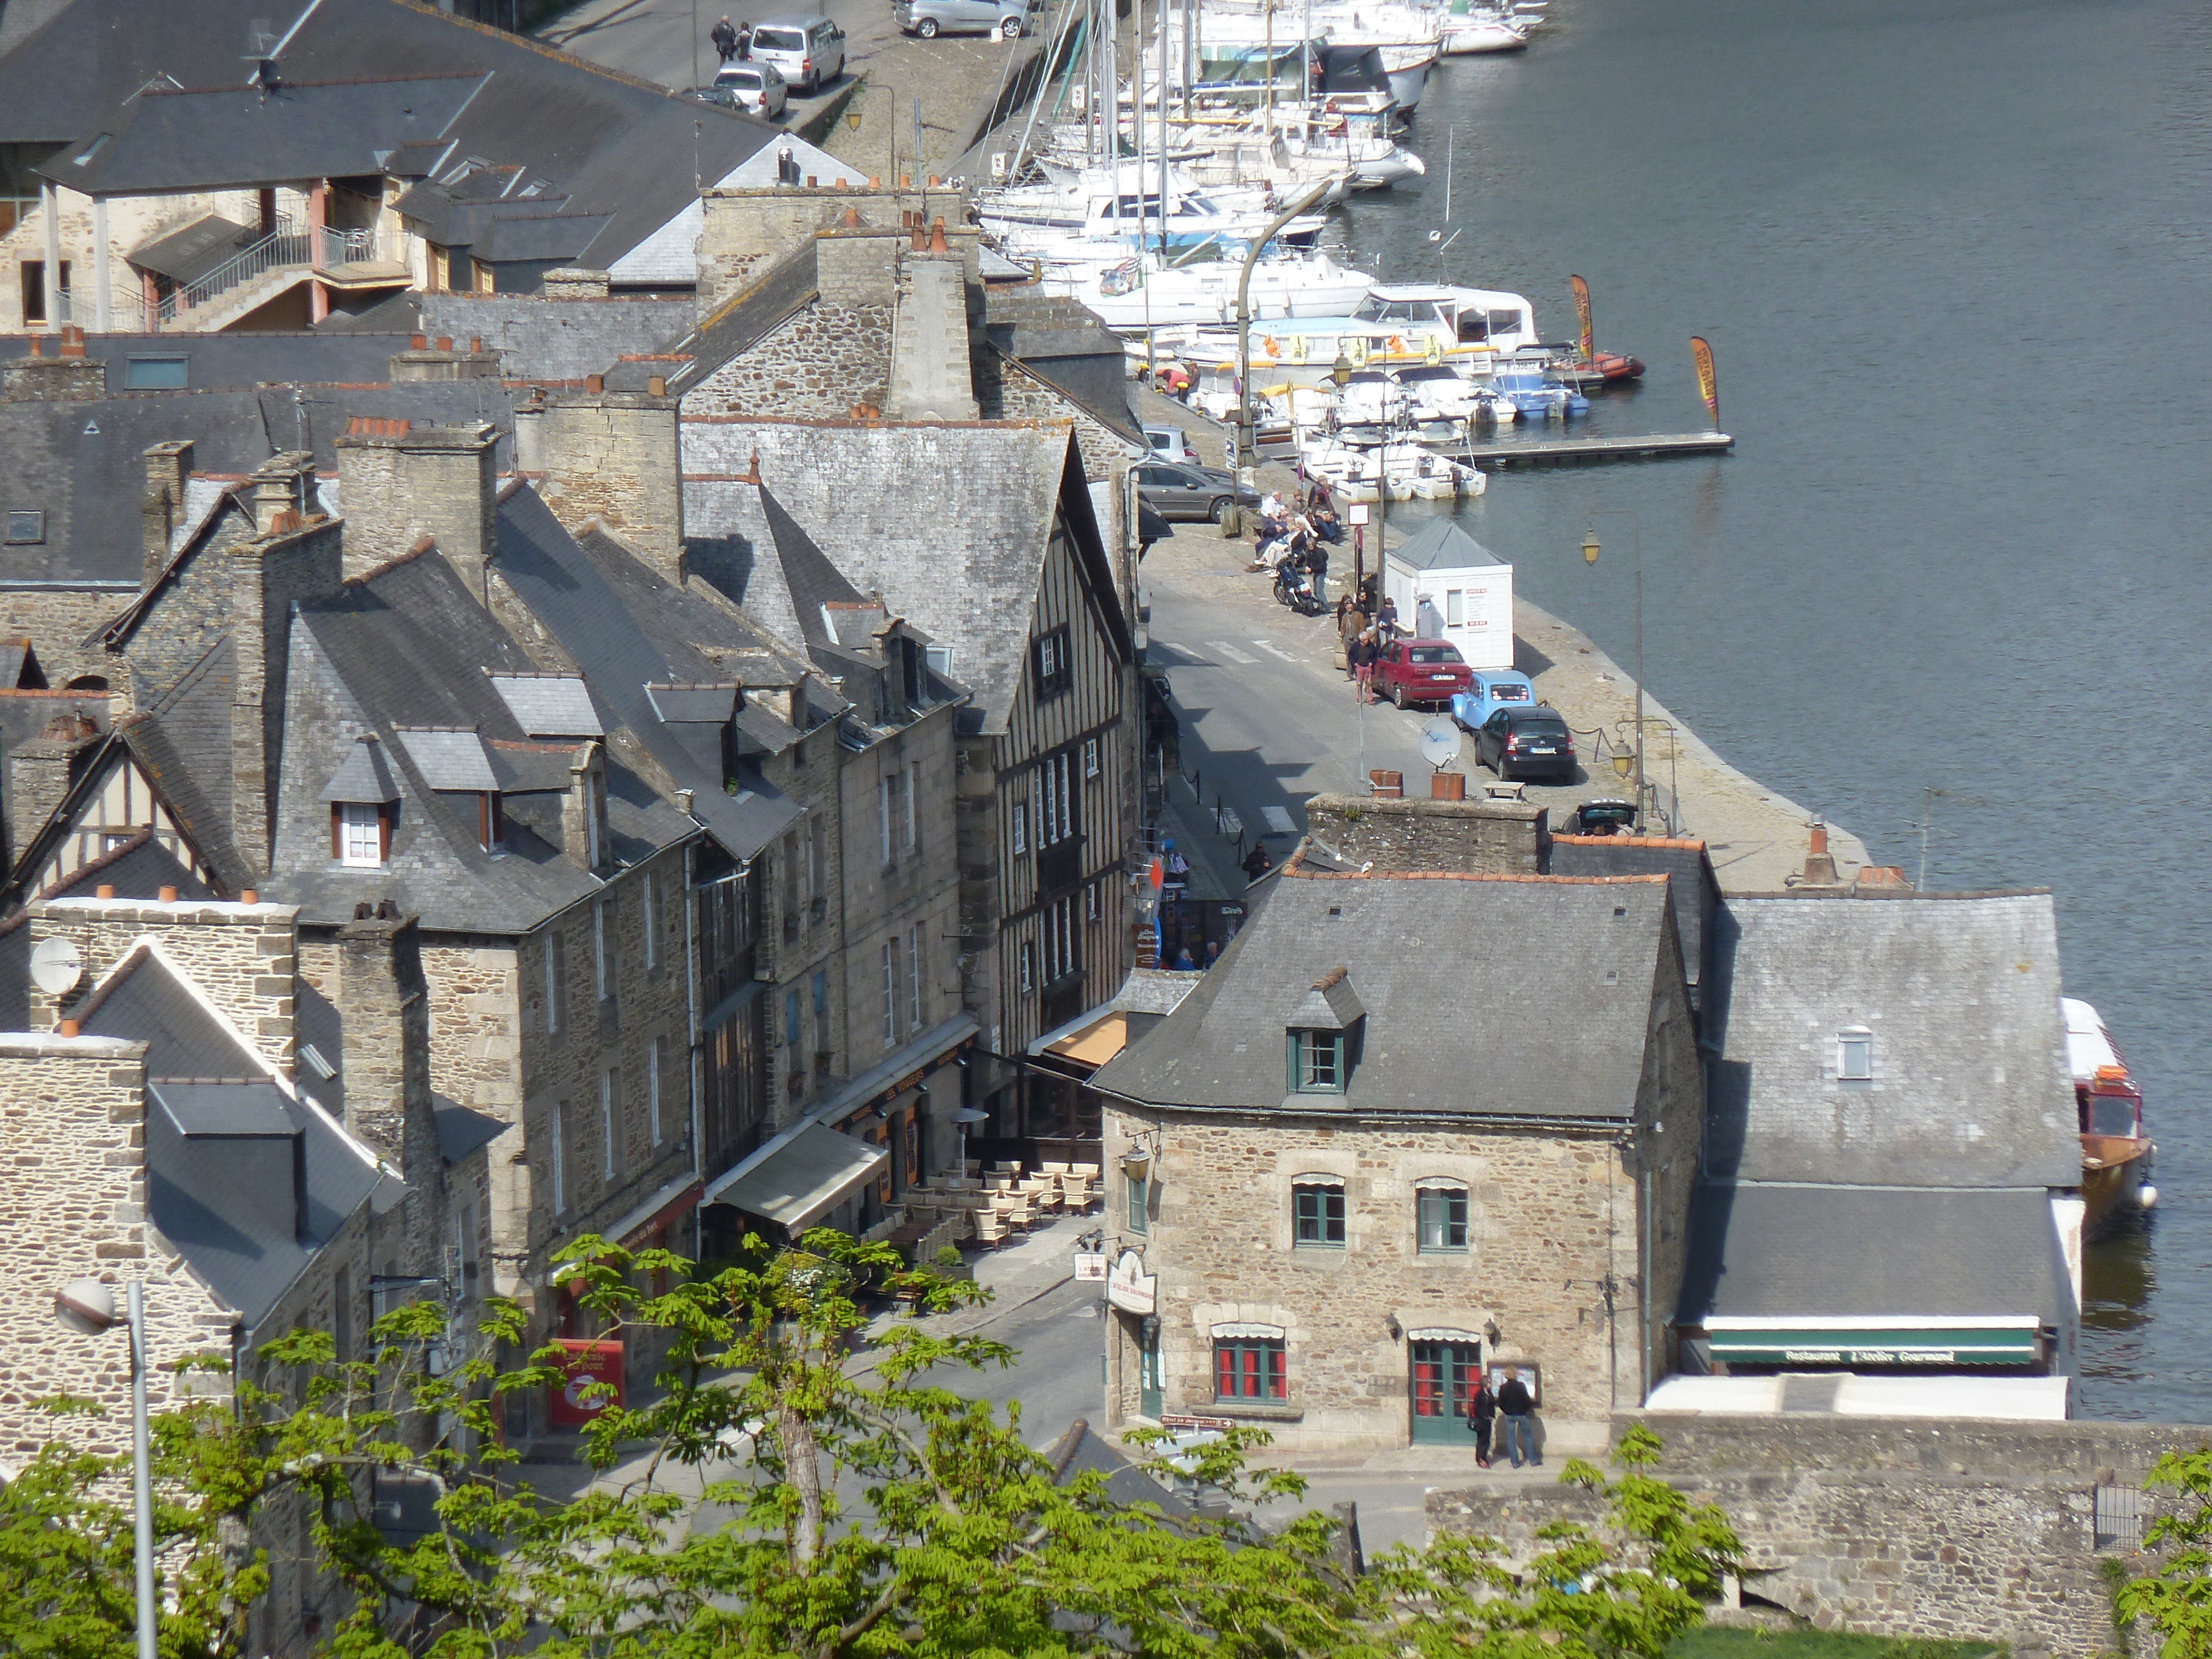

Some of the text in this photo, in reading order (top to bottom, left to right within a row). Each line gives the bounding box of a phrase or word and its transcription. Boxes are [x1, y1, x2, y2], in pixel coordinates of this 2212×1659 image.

[1109, 1282, 1154, 1300] L'ATELIER GOURMAND
[1785, 1350, 1954, 1362] Restaurant L'Atelier Gourmand
